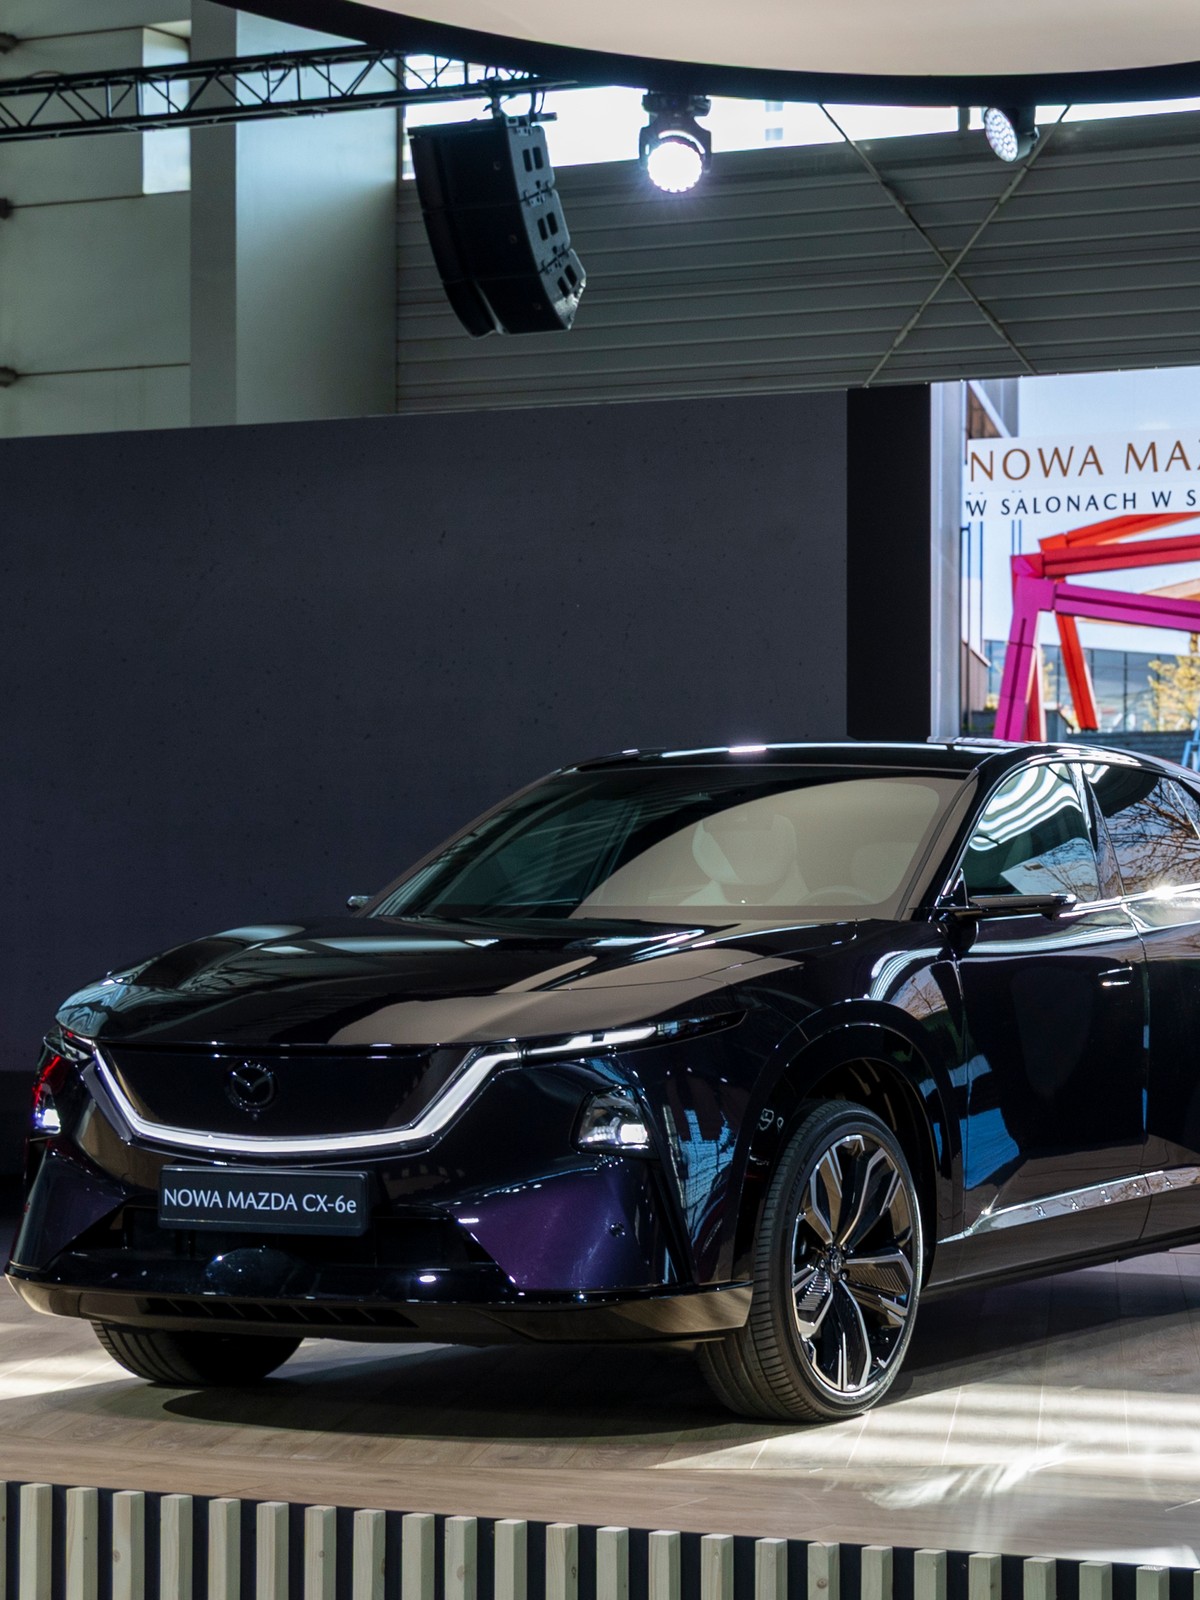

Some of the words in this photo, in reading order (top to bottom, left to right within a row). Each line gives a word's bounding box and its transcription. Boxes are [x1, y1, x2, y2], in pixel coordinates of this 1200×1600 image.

[970, 445, 1104, 482] NOWA
[966, 499, 987, 517] W
[1000, 492, 1137, 516] SALONACH
[1151, 490, 1172, 508] W
[163, 1188, 223, 1209] NOWA
[227, 1190, 298, 1212] MAZDA
[302, 1194, 357, 1214] CX-6e
